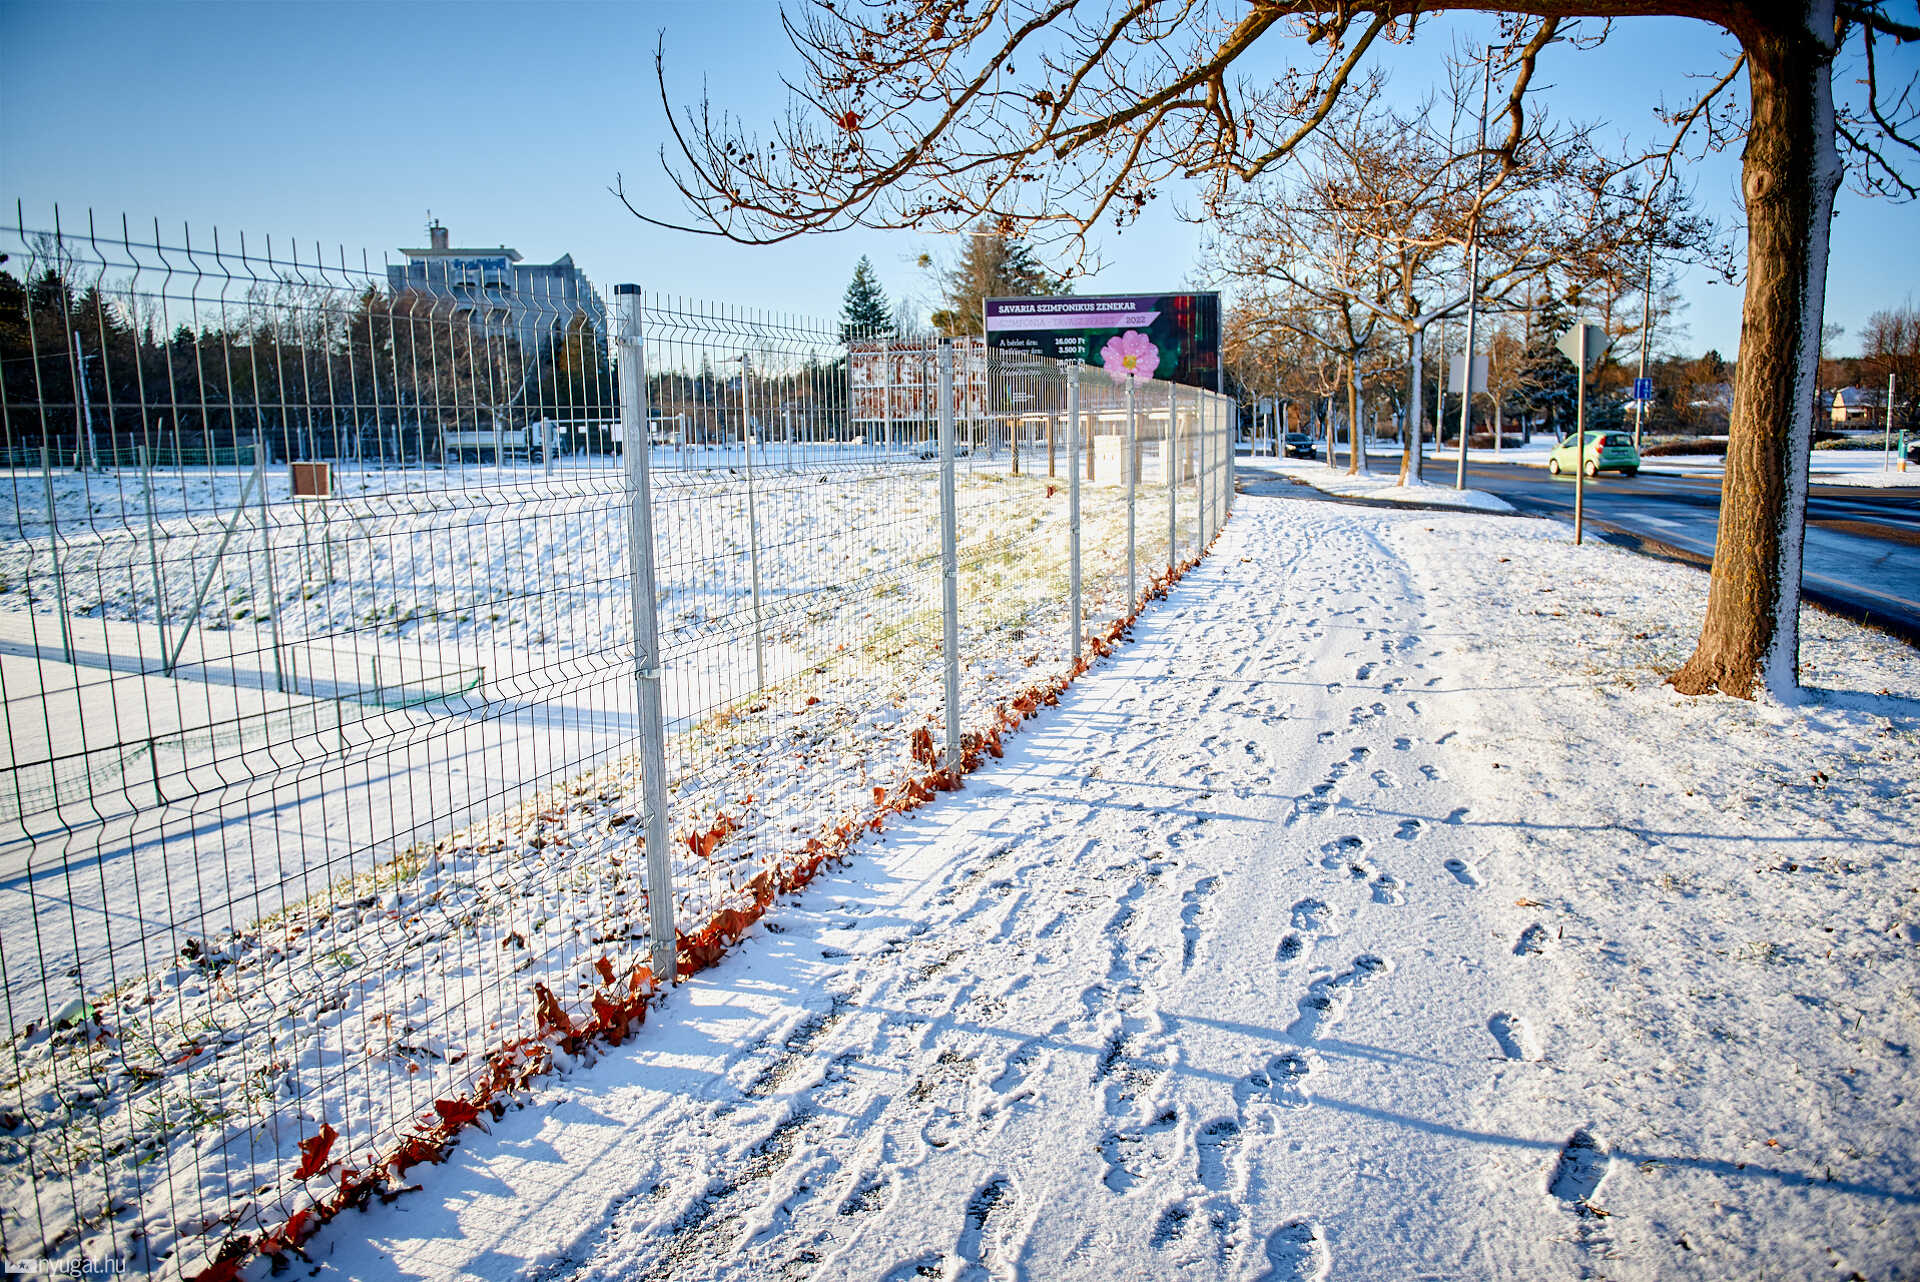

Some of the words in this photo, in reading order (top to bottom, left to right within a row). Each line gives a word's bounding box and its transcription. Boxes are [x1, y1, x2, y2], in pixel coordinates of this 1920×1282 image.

[998, 304, 1036, 314] SAVARIA
[1037, 303, 1095, 313] SZIMFONIKUS
[1096, 302, 1136, 312] ZENEKAR
[1125, 316, 1146, 324] 2022
[1077, 337, 1086, 345] Ft
